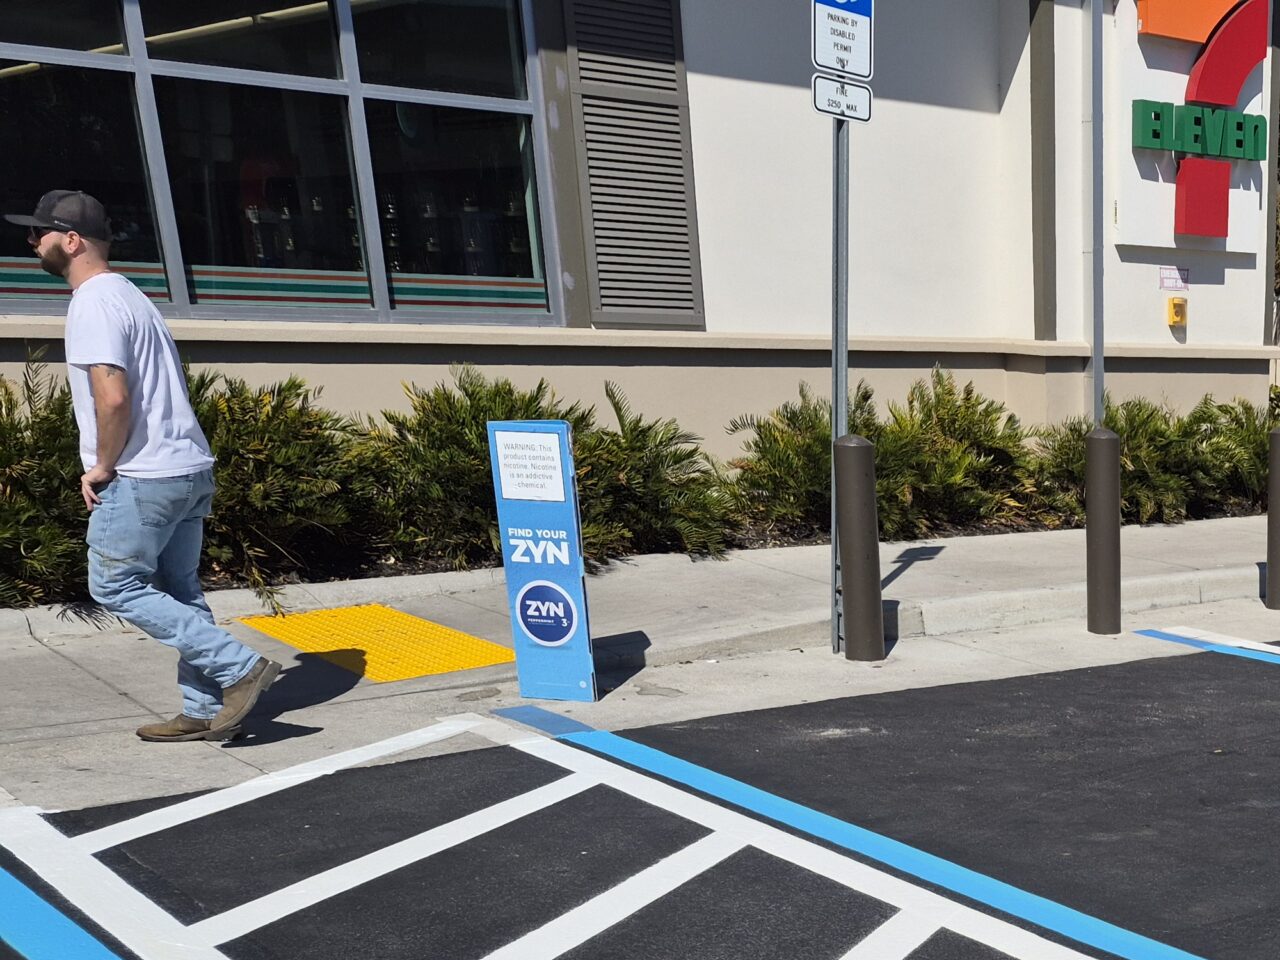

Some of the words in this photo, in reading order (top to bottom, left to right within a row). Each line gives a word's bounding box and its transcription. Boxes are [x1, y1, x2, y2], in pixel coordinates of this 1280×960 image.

[827, 12, 849, 25] PARKING
[850, 18, 858, 27] BY
[830, 27, 855, 41] DISABLED
[833, 42, 852, 54] PERMIT
[835, 86, 848, 98] FINE
[846, 103, 857, 112] MAX
[539, 444, 553, 452] This
[503, 453, 528, 461] product
[528, 454, 555, 462] contains
[530, 463, 557, 471] Nicotine
[525, 473, 553, 481] addictive
[508, 528, 533, 537] FIND
[536, 530, 567, 539] YOUR
[509, 539, 570, 565] ZYN
[525, 600, 565, 617] ZYN
[561, 618, 568, 627] 3
